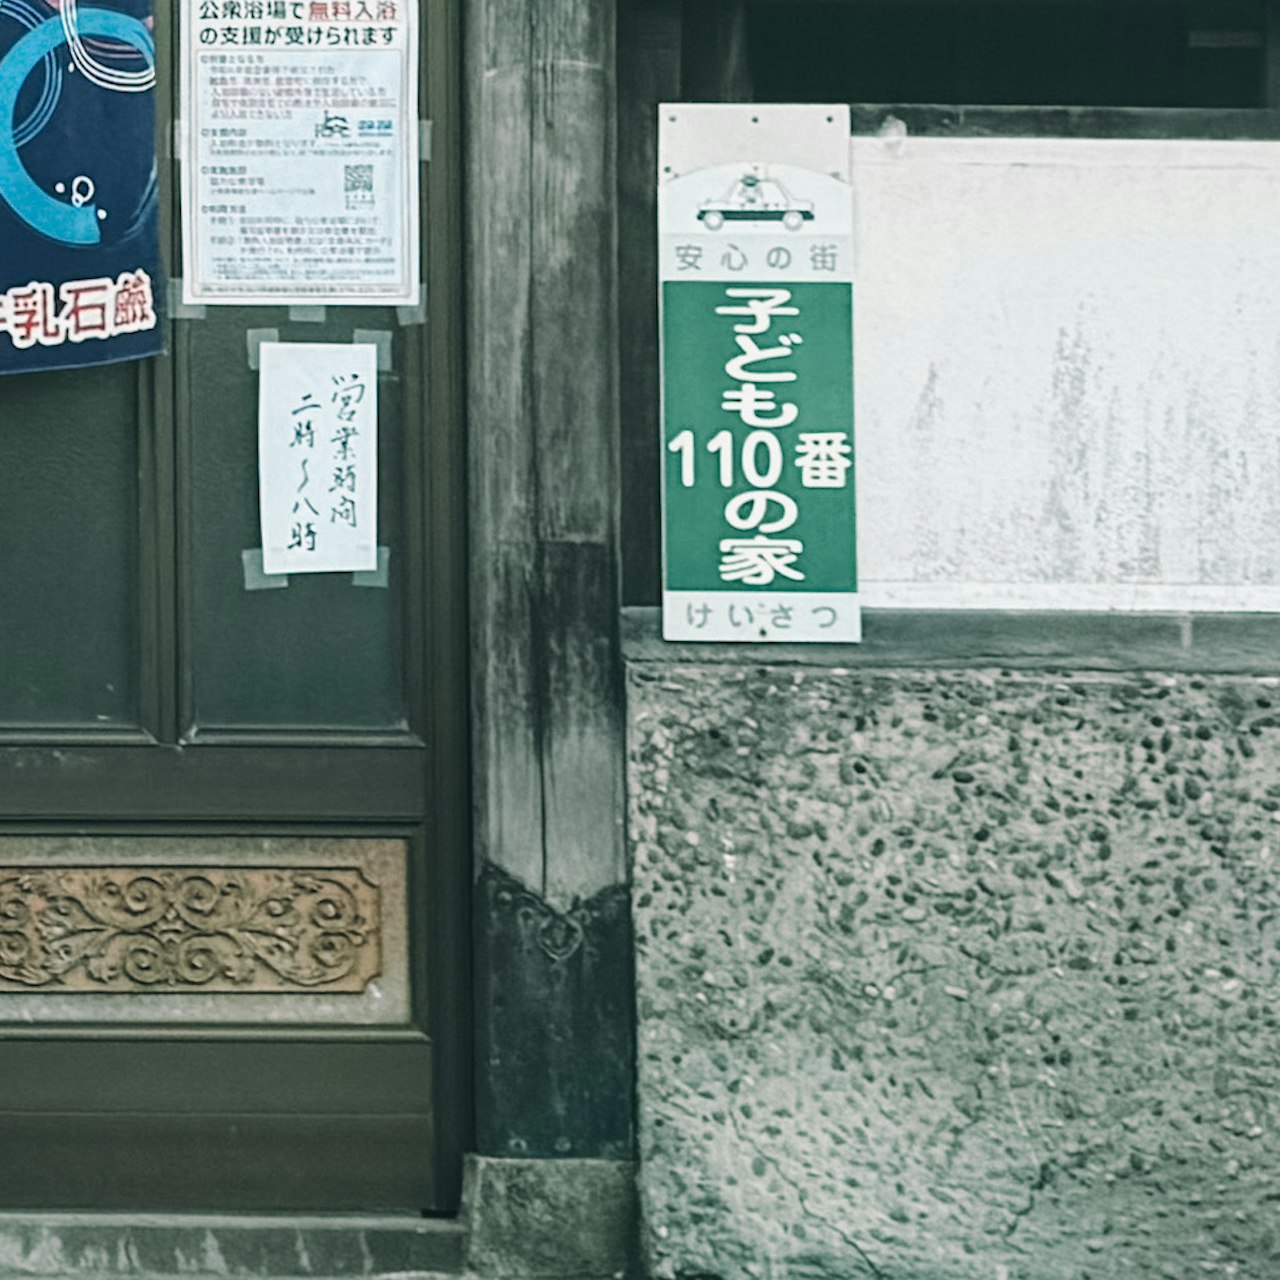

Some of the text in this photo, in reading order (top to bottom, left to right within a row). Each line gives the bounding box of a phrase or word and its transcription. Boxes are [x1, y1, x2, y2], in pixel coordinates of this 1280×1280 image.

[199, 0, 397, 21] 公衆浴場で無料入浴
[199, 27, 397, 46] の支援が受けられます
[675, 243, 838, 272] 安心の街
[329, 373, 365, 527] 営業時間
[686, 602, 838, 630] けいさつ
